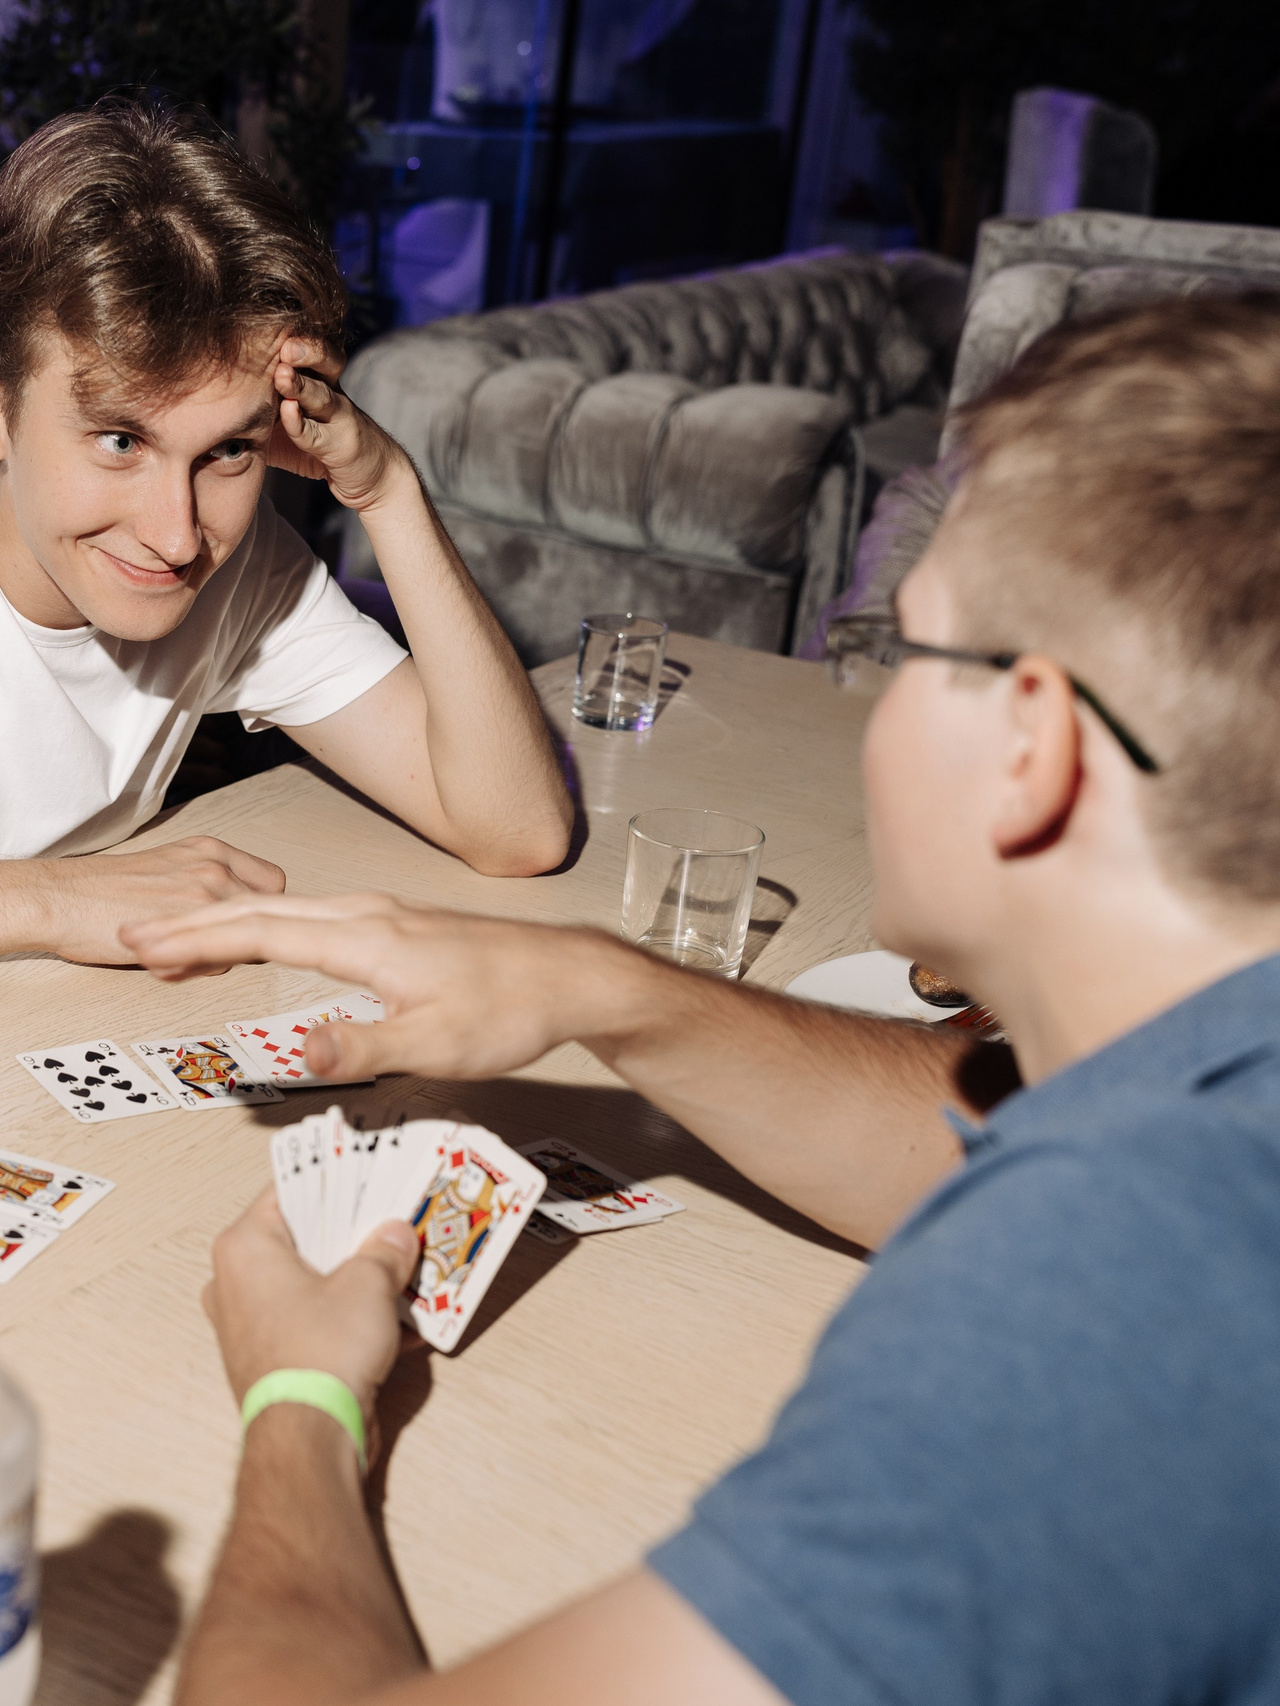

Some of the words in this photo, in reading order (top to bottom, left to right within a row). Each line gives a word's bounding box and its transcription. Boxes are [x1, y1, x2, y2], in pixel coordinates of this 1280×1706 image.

[307, 1017, 319, 1027] 9
[231, 1024, 244, 1033] 9
[98, 1042, 111, 1052] 9
[23, 1055, 36, 1065] 9
[156, 1095, 169, 1106] 9
[78, 1109, 91, 1120] 9
